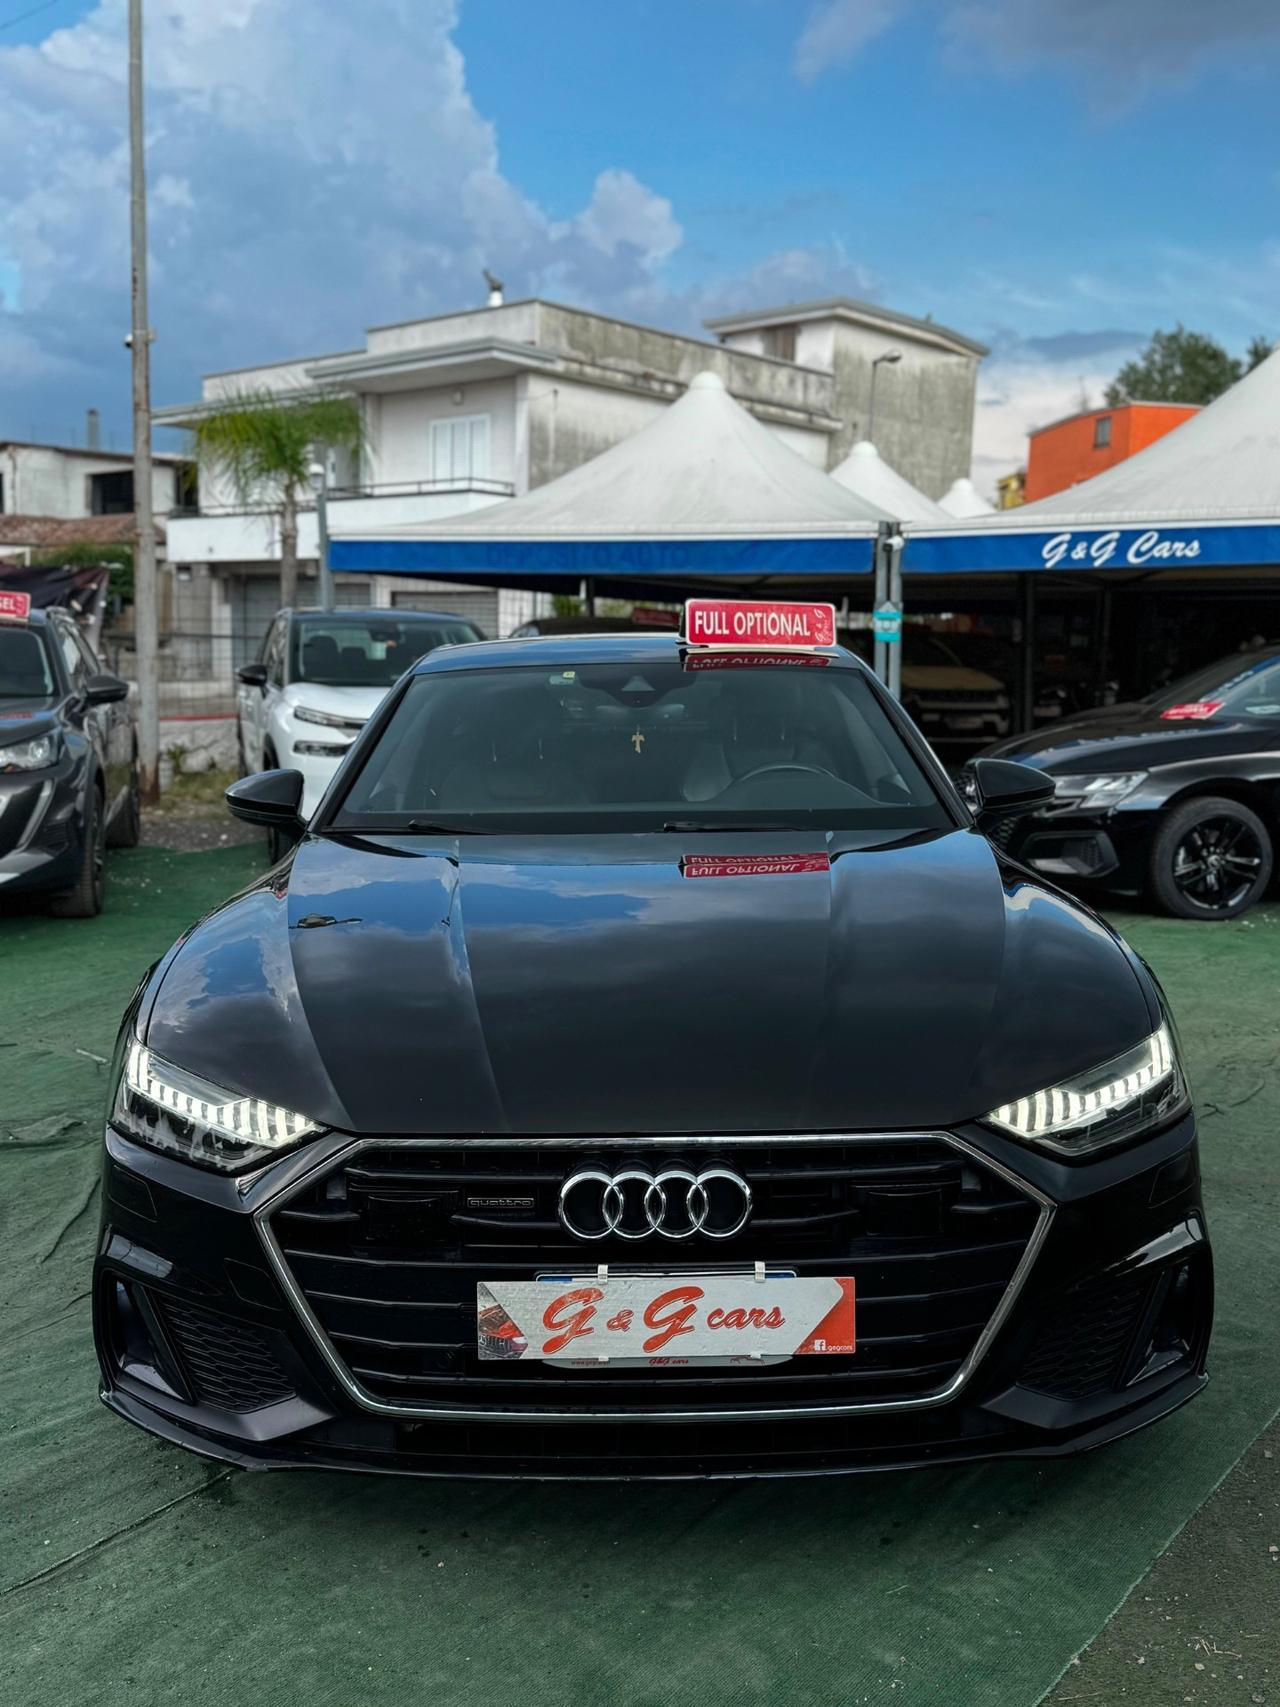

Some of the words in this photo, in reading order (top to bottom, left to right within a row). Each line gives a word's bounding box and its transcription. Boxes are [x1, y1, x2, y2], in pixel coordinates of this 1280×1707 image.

[1126, 531, 1201, 564] Cars
[695, 611, 730, 635] FULL
[734, 612, 811, 636] OPTIONAL
[471, 1200, 531, 1208] quattro
[543, 1287, 605, 1354] G
[607, 1309, 634, 1332] &
[643, 1286, 705, 1353] G
[707, 1306, 786, 1329] cars
